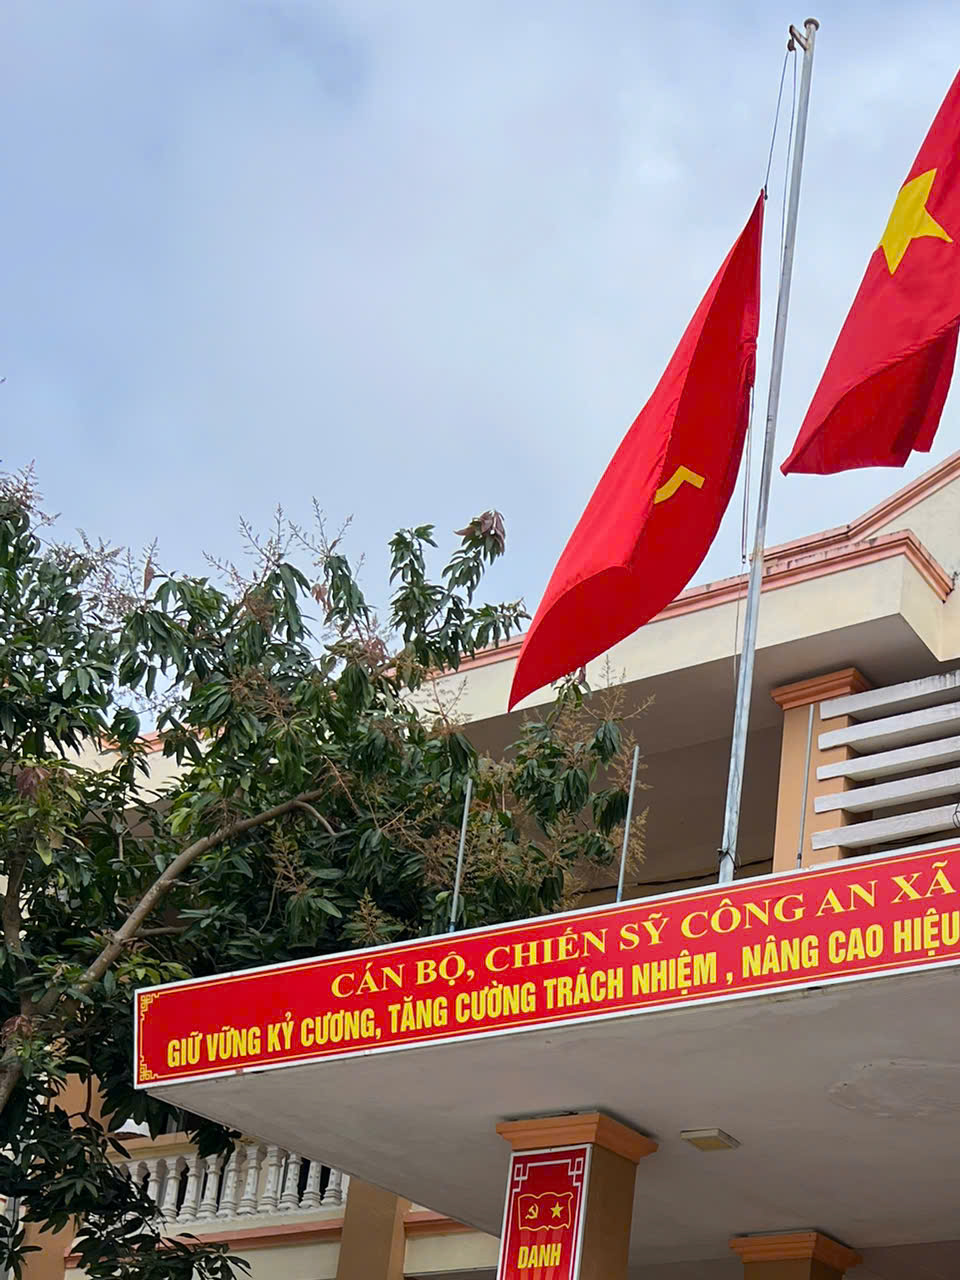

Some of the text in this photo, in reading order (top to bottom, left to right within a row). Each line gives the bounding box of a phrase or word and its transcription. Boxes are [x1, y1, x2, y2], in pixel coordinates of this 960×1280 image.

[168, 1032, 202, 1067] GIỮ
[207, 1026, 260, 1061] VỮNG
[268, 1012, 294, 1052] KỶ
[301, 1008, 381, 1046] CƯƠNG,
[388, 996, 447, 1033] TĂNG
[456, 981, 535, 1023] CƯỜNG
[544, 968, 623, 1008] TRÁCH
[632, 950, 716, 995] NHIỆM
[742, 936, 818, 978] NÂNG
[829, 925, 883, 963] CAO
[894, 908, 960, 956] HIỆU
[332, 963, 403, 997] CÁN
[416, 952, 474, 985] BỘ,
[486, 928, 606, 971] CHIẾN
[620, 914, 668, 950] SỸ
[681, 895, 804, 938] CÔNG
[816, 879, 879, 916] AN
[892, 861, 955, 903] XÃ
[518, 1244, 560, 1268] DANH
